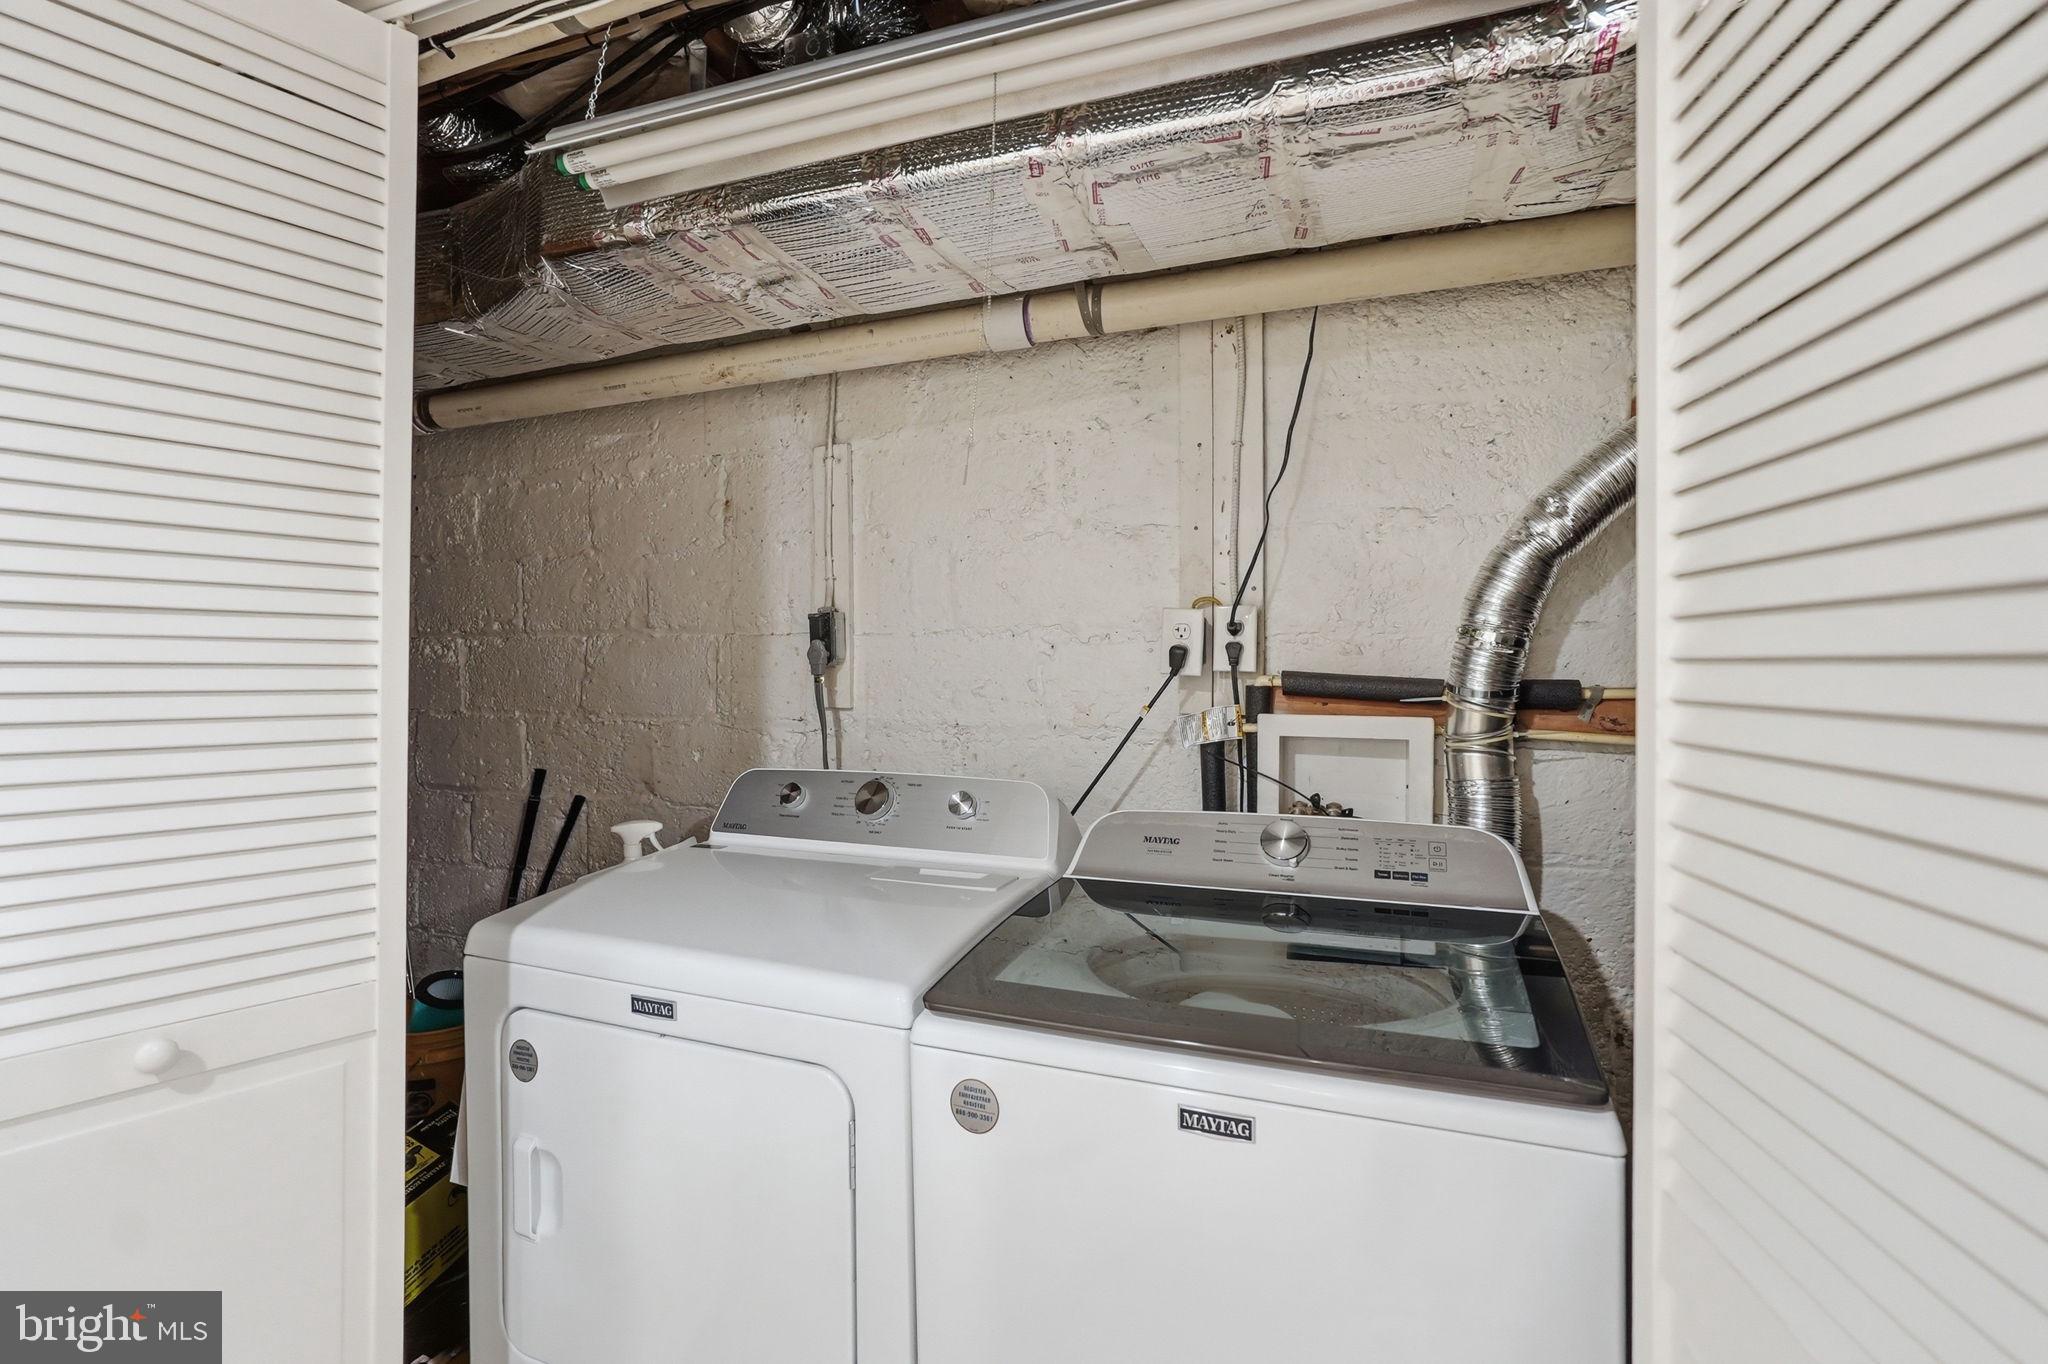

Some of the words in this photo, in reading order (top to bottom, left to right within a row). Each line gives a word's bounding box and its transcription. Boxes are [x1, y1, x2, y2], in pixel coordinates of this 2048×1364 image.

[1143, 836, 1180, 845] MAYTAG
[633, 1000, 672, 1016] MAYTAG
[1182, 1112, 1250, 1137] MAYTAG
